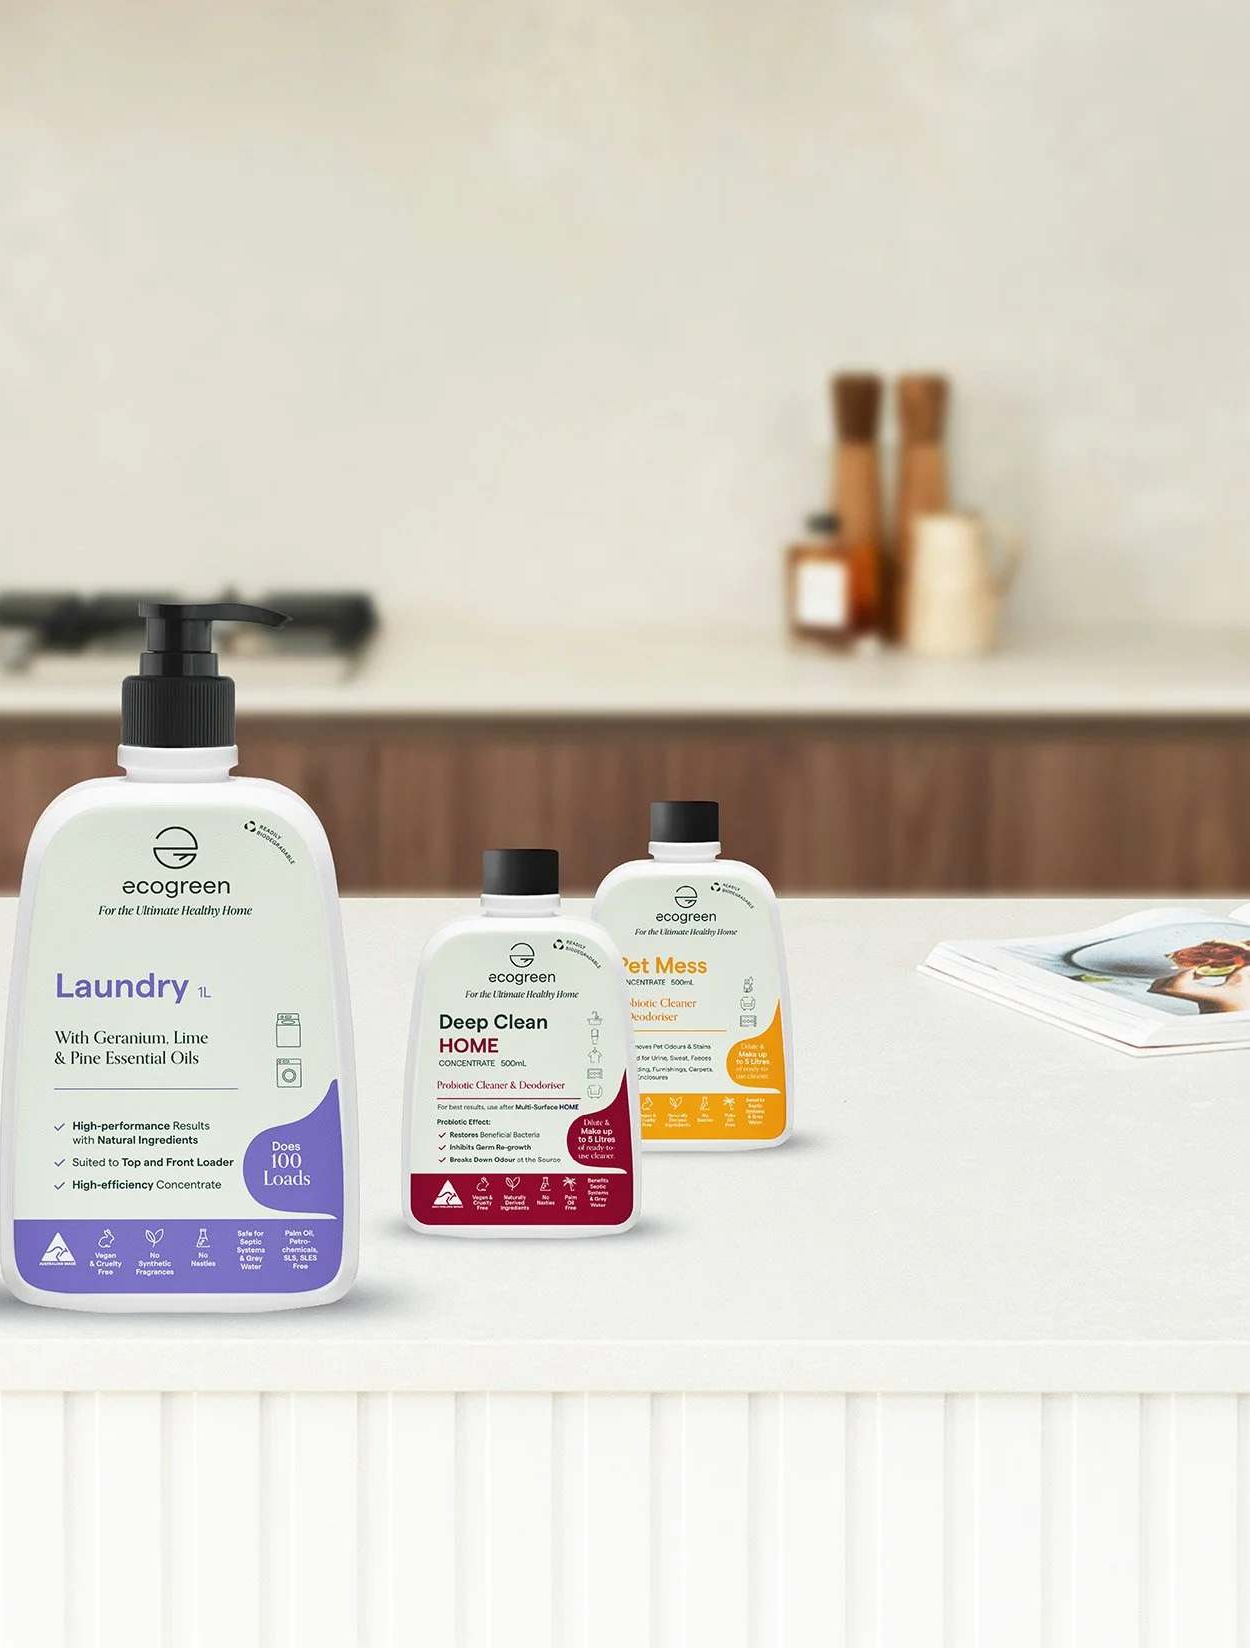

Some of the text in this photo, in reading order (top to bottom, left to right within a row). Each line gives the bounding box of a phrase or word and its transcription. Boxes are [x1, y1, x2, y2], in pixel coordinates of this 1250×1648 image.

[257, 823, 283, 841] READILY
[255, 830, 296, 866] BIODEGRADABLE
[122, 881, 230, 899] ecogreen
[98, 905, 253, 918] For the Ultimate Healthy Home
[656, 913, 716, 924] ecogreen
[655, 956, 707, 974] Mess
[488, 973, 556, 986] ecogreen
[57, 972, 211, 1004] Laundry 1L
[660, 998, 697, 1008] Cleaner
[440, 1014, 548, 1033] Deep Clean
[55, 1030, 89, 1045] With
[174, 1030, 208, 1044] Lime
[440, 1038, 499, 1053] HOME
[54, 1050, 199, 1065] & Pine Essential Oils
[438, 1059, 527, 1067] CONCENTRATE 500mL
[437, 1080, 565, 1090] Probiotic Cleaner & Deodoriser
[73, 1121, 210, 1133] High-performance Results
[72, 1135, 198, 1147] with Natural Ingredients
[450, 1131, 540, 1139] Restores Beneficial Bacteria
[272, 1141, 301, 1151] Does
[496, 1144, 532, 1152] Re-growth
[72, 1157, 234, 1169] Suited to Top and Front Loader
[272, 1153, 302, 1169] 100
[264, 1170, 311, 1186] Loads
[72, 1180, 222, 1192] High-efficiency Concentrate
[95, 1252, 117, 1260] Vegan
[96, 1260, 122, 1268] Cruelty
[138, 1260, 171, 1268] Synthetic
[136, 1268, 174, 1277] Fragrances
